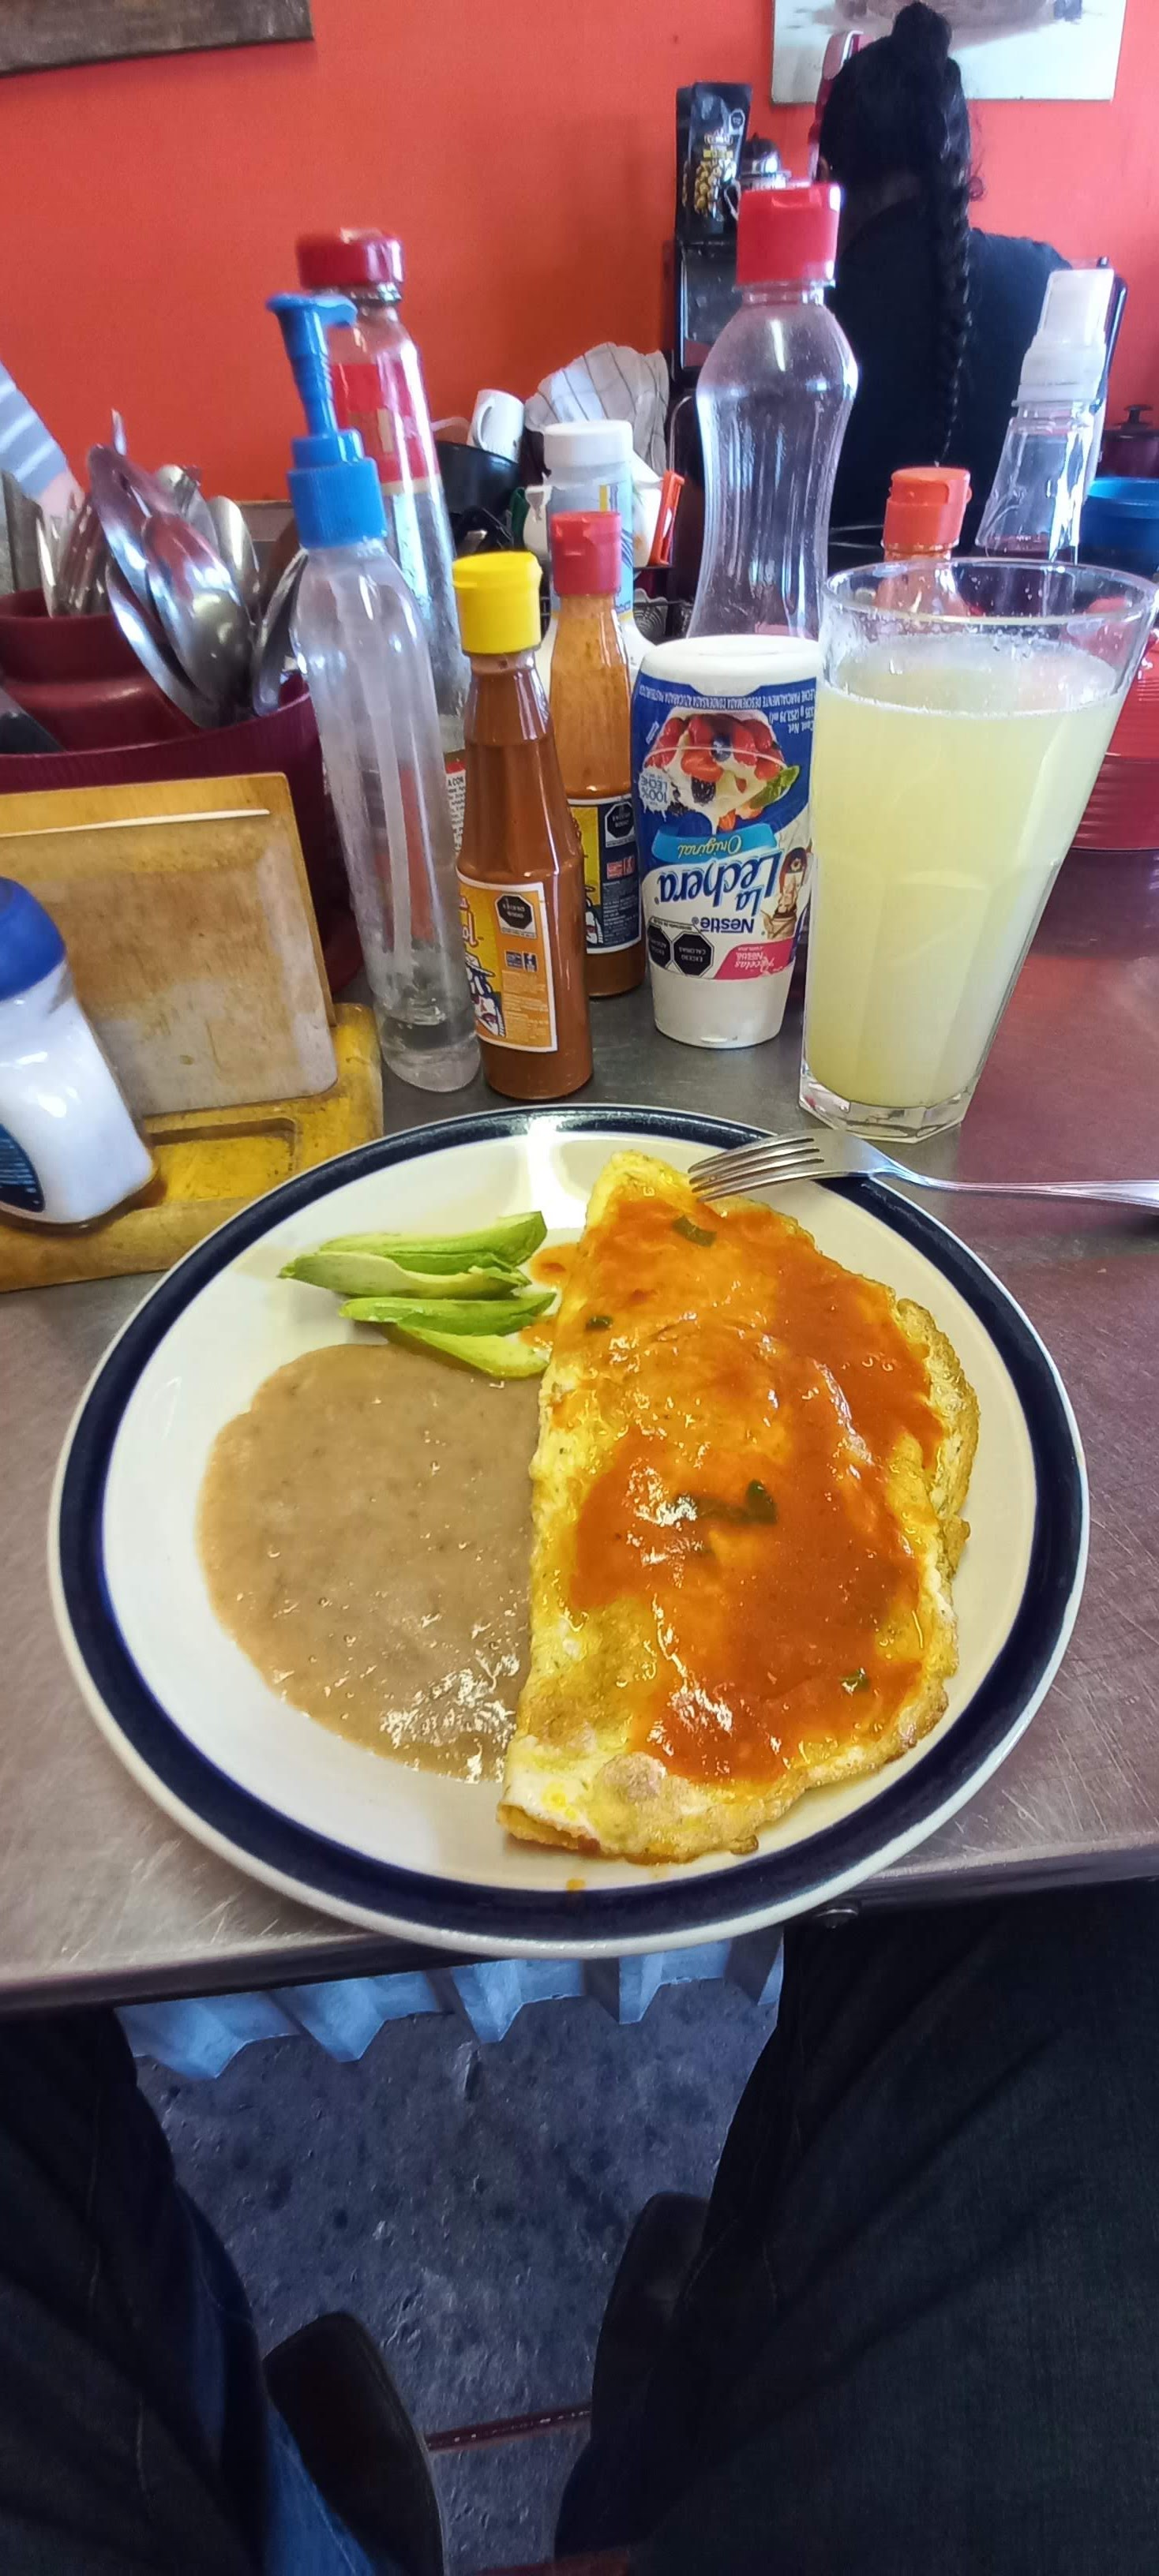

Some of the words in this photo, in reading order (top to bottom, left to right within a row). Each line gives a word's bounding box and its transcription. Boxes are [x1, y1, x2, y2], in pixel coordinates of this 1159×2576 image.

[641, 774, 667, 790] LECHE
[642, 786, 667, 803] 100%
[677, 834, 742, 859] Original
[658, 851, 784, 908] Lechera
[735, 885, 763, 917] La
